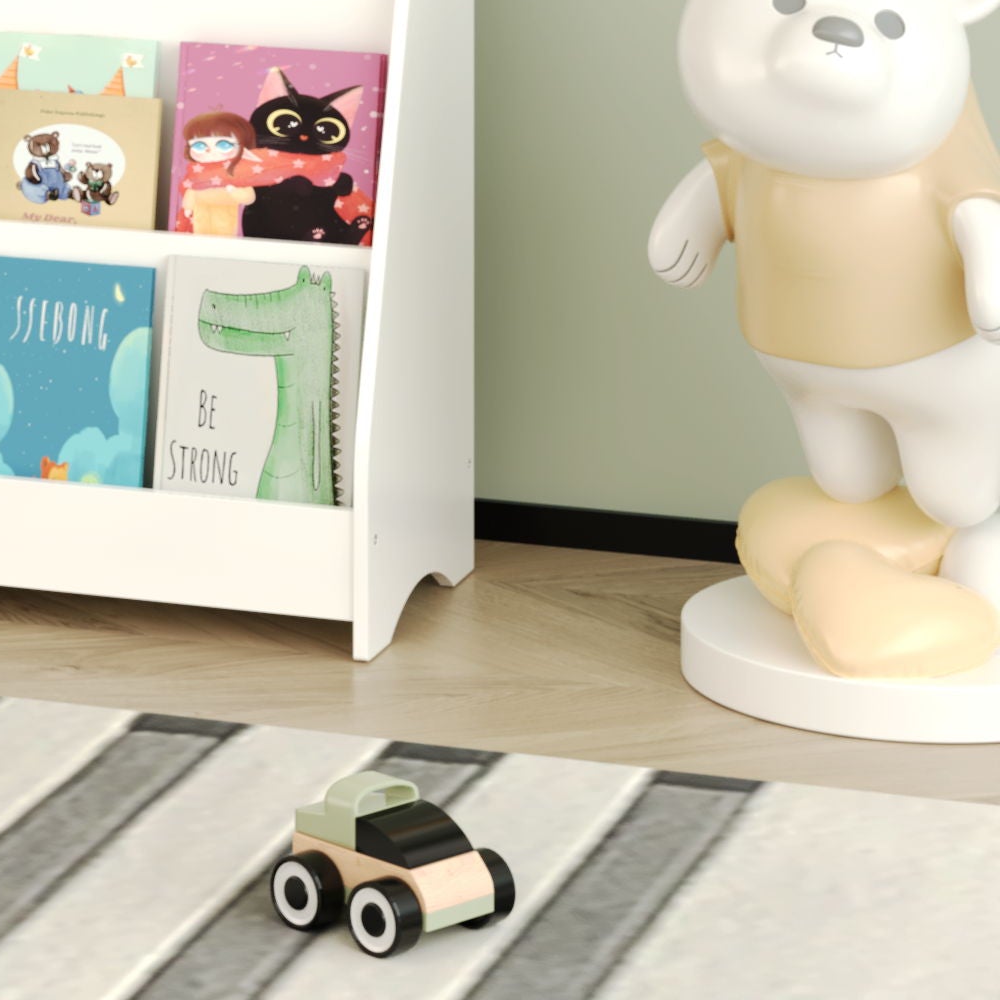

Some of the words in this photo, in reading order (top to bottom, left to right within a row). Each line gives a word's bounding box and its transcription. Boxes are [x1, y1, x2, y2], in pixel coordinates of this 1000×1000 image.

[9, 295, 109, 352] SSEBONG
[198, 389, 218, 430] BE
[167, 440, 239, 487] STRONG
